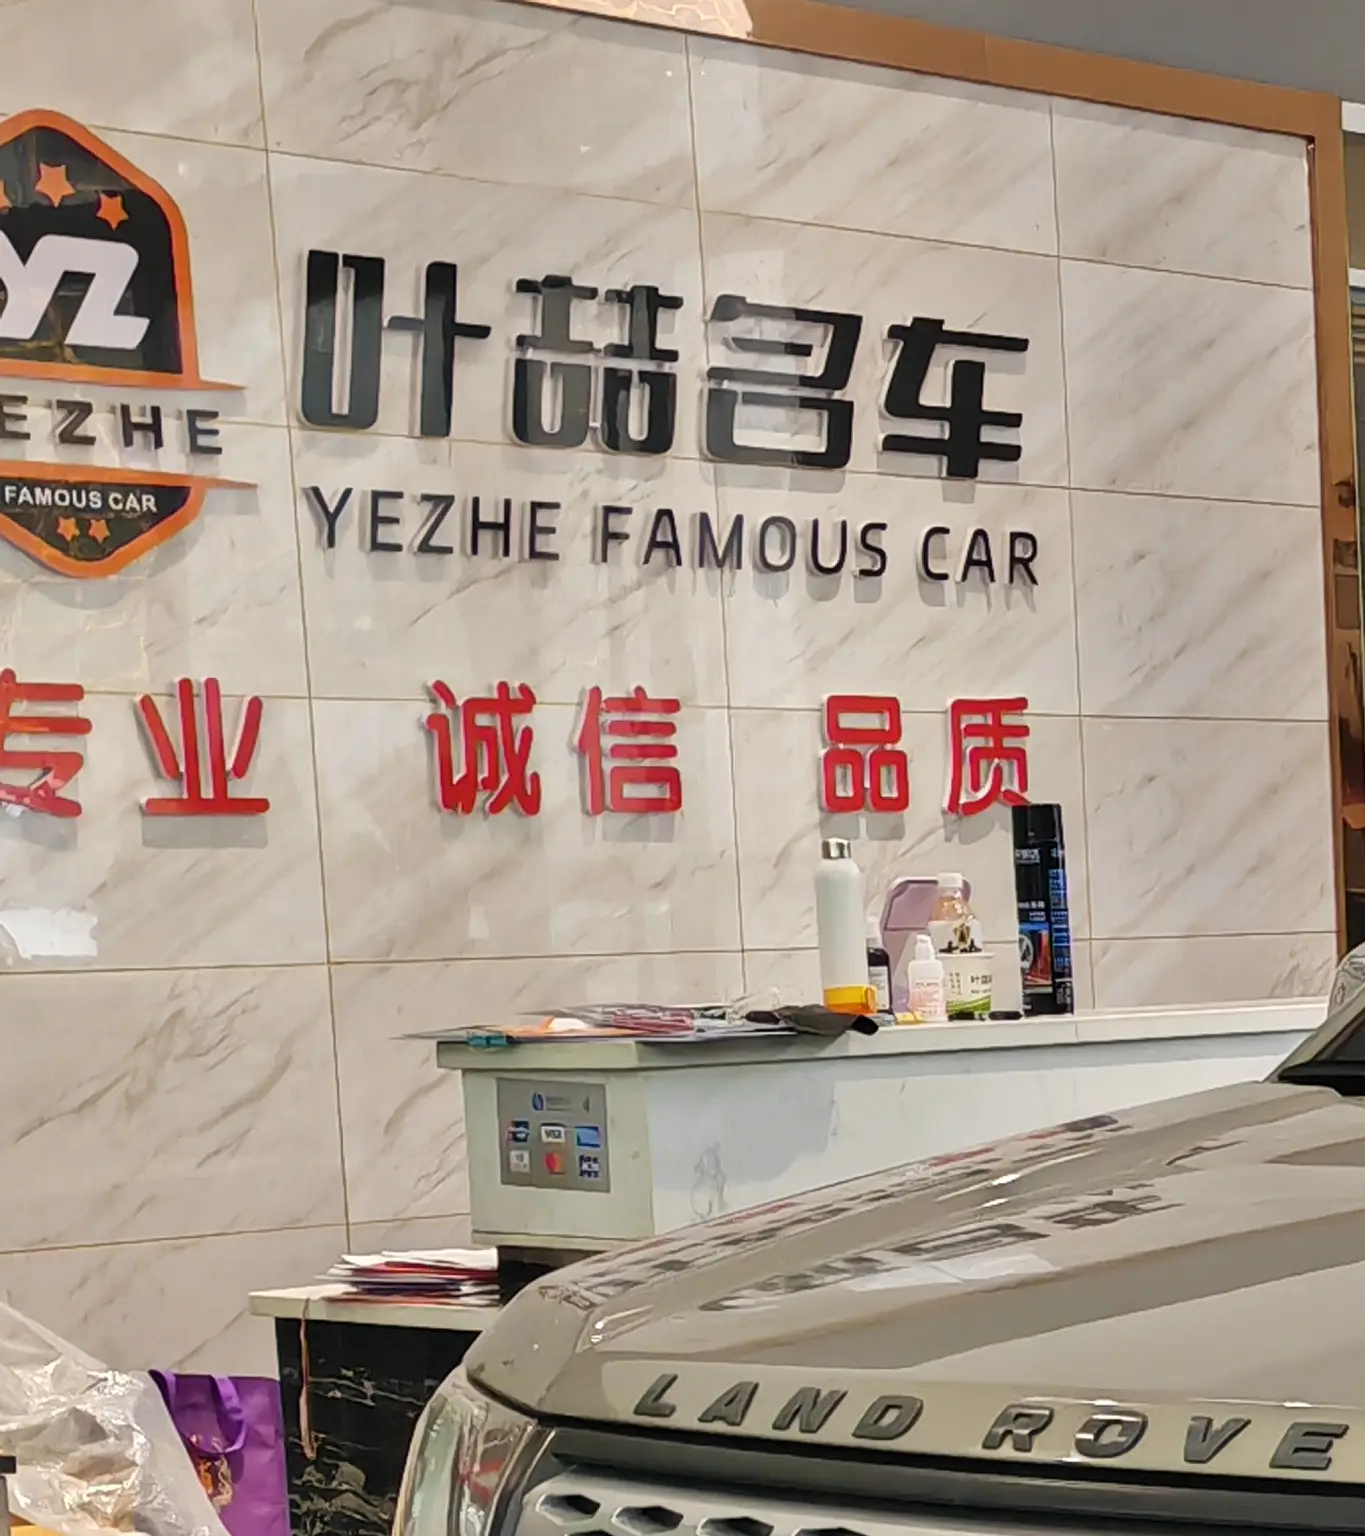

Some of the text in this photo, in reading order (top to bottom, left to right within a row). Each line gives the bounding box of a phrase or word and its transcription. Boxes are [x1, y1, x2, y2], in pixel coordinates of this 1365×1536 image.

[301, 249, 1030, 479] 叶喆名车
[4, 484, 158, 513] FAMOUS CAR
[309, 485, 1040, 586] YEZHE FAMOUS CAR
[426, 680, 682, 815] 诚信
[822, 694, 1031, 816] 品质
[632, 1372, 924, 1441] LAND
